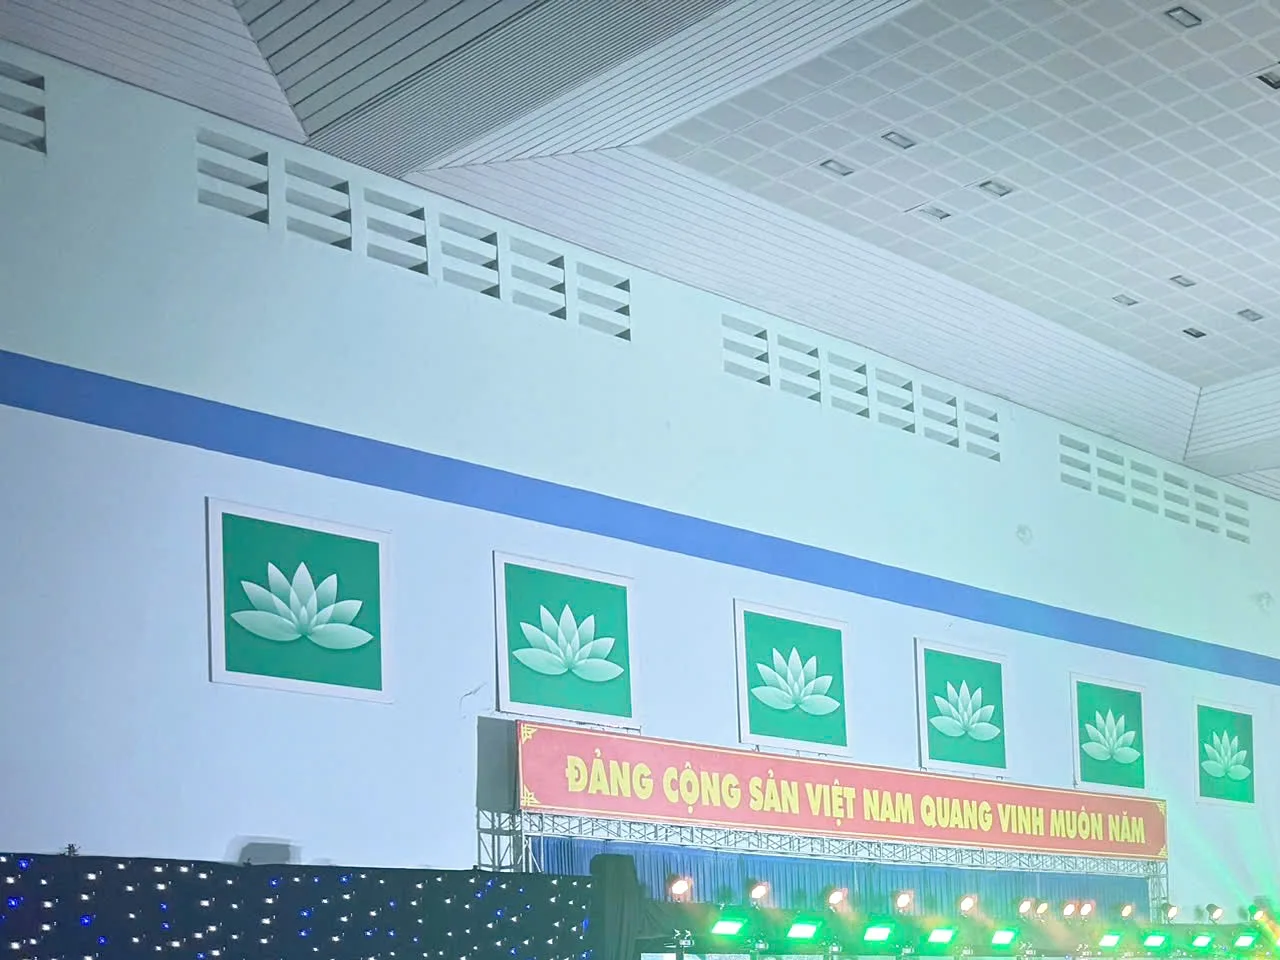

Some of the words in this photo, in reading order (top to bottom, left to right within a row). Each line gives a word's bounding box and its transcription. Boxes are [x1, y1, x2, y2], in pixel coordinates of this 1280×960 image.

[565, 748, 654, 800] ĐẢNG
[663, 762, 742, 814] CỘNG
[749, 769, 799, 814] SẢN
[805, 779, 857, 826] VIỆT
[863, 788, 915, 825] NAM
[920, 795, 993, 832] QUANG
[997, 803, 1045, 836] VINH
[1050, 806, 1104, 841] MUÔN
[1108, 810, 1146, 844] NĂM
